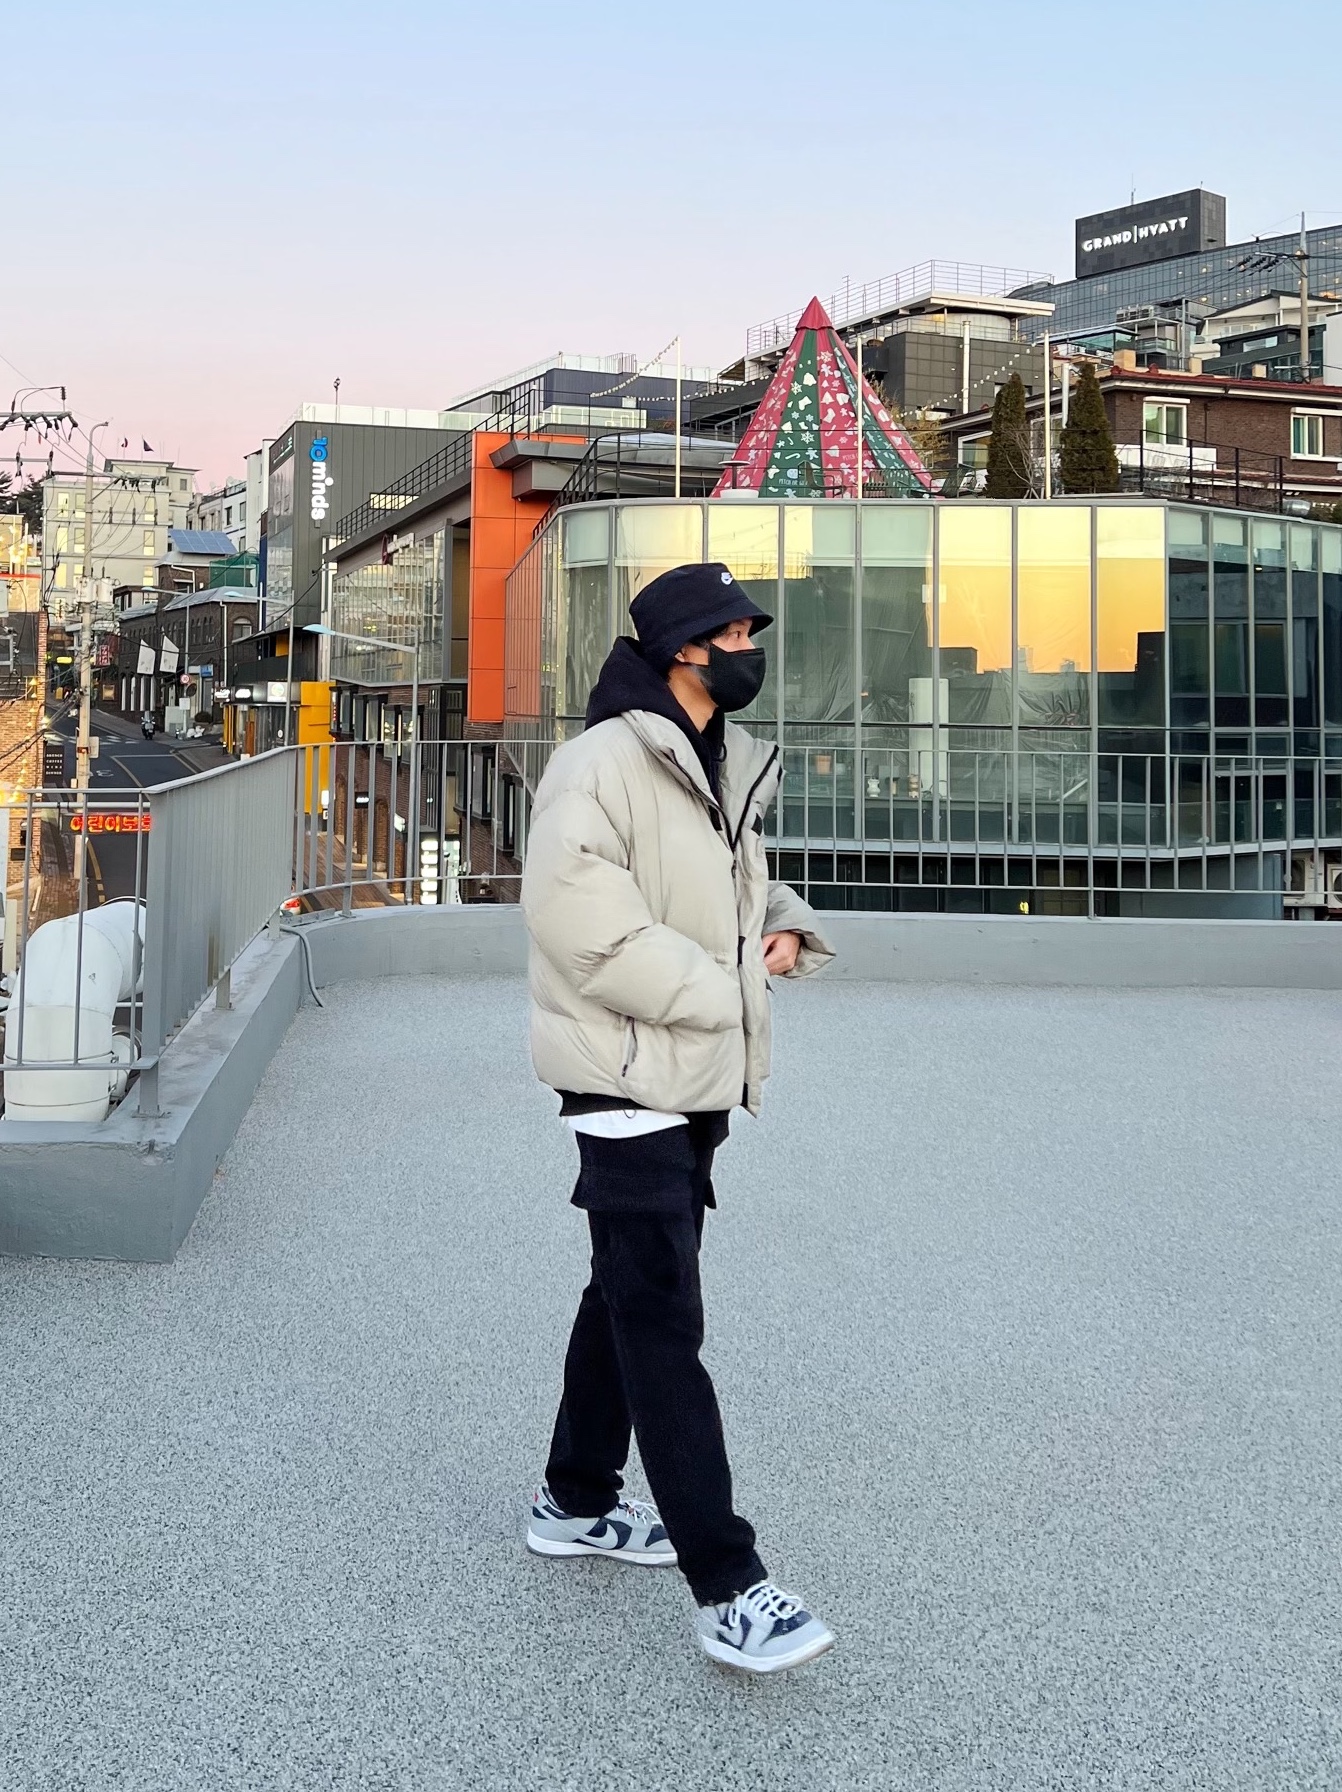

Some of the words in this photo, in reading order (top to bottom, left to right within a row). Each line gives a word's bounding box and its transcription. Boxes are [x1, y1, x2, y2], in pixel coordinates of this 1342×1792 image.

[1082, 230, 1133, 252] GRAND
[1138, 216, 1189, 239] HYATT
[309, 436, 334, 520] 10minds
